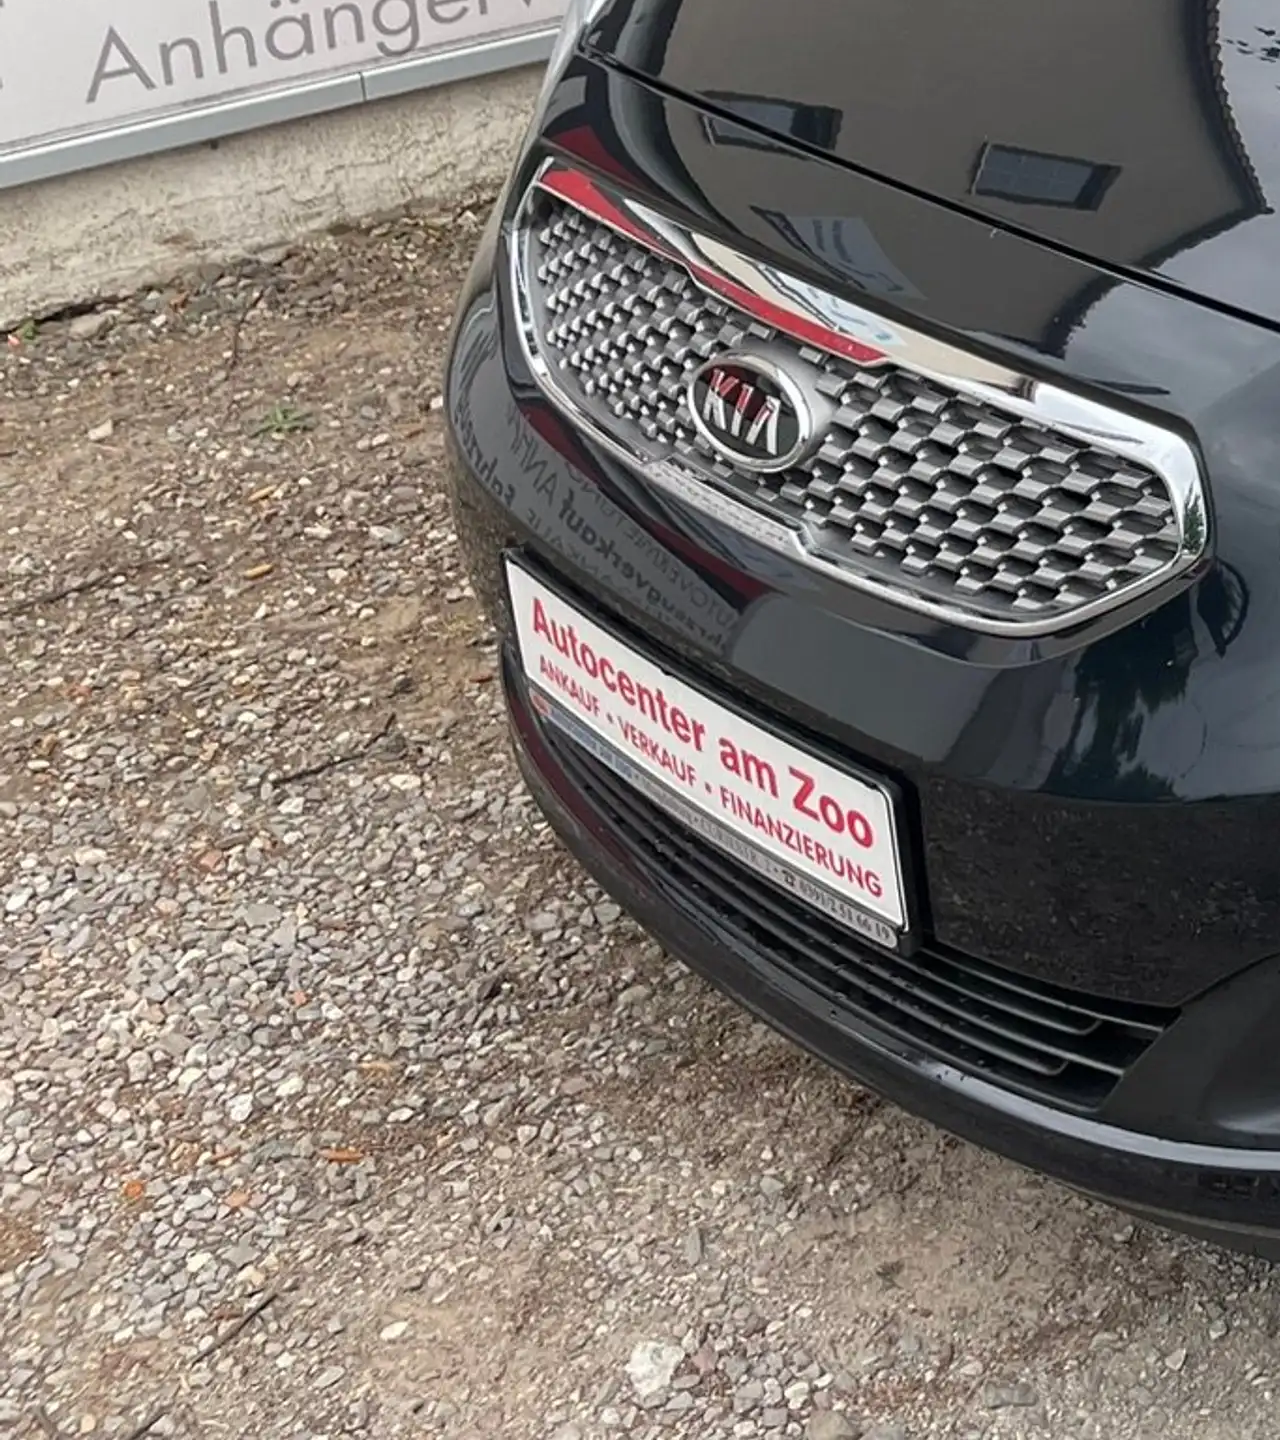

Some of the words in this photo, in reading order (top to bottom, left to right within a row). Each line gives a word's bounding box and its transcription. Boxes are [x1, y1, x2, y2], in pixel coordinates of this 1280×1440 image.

[703, 368, 782, 456] KIA
[533, 597, 706, 752] Autocenter
[718, 736, 778, 799] am
[789, 766, 874, 849] Zoo
[539, 655, 601, 717] ANKAUF
[617, 716, 697, 787] VERKAUF
[720, 786, 883, 898] FINANZIERUNG
